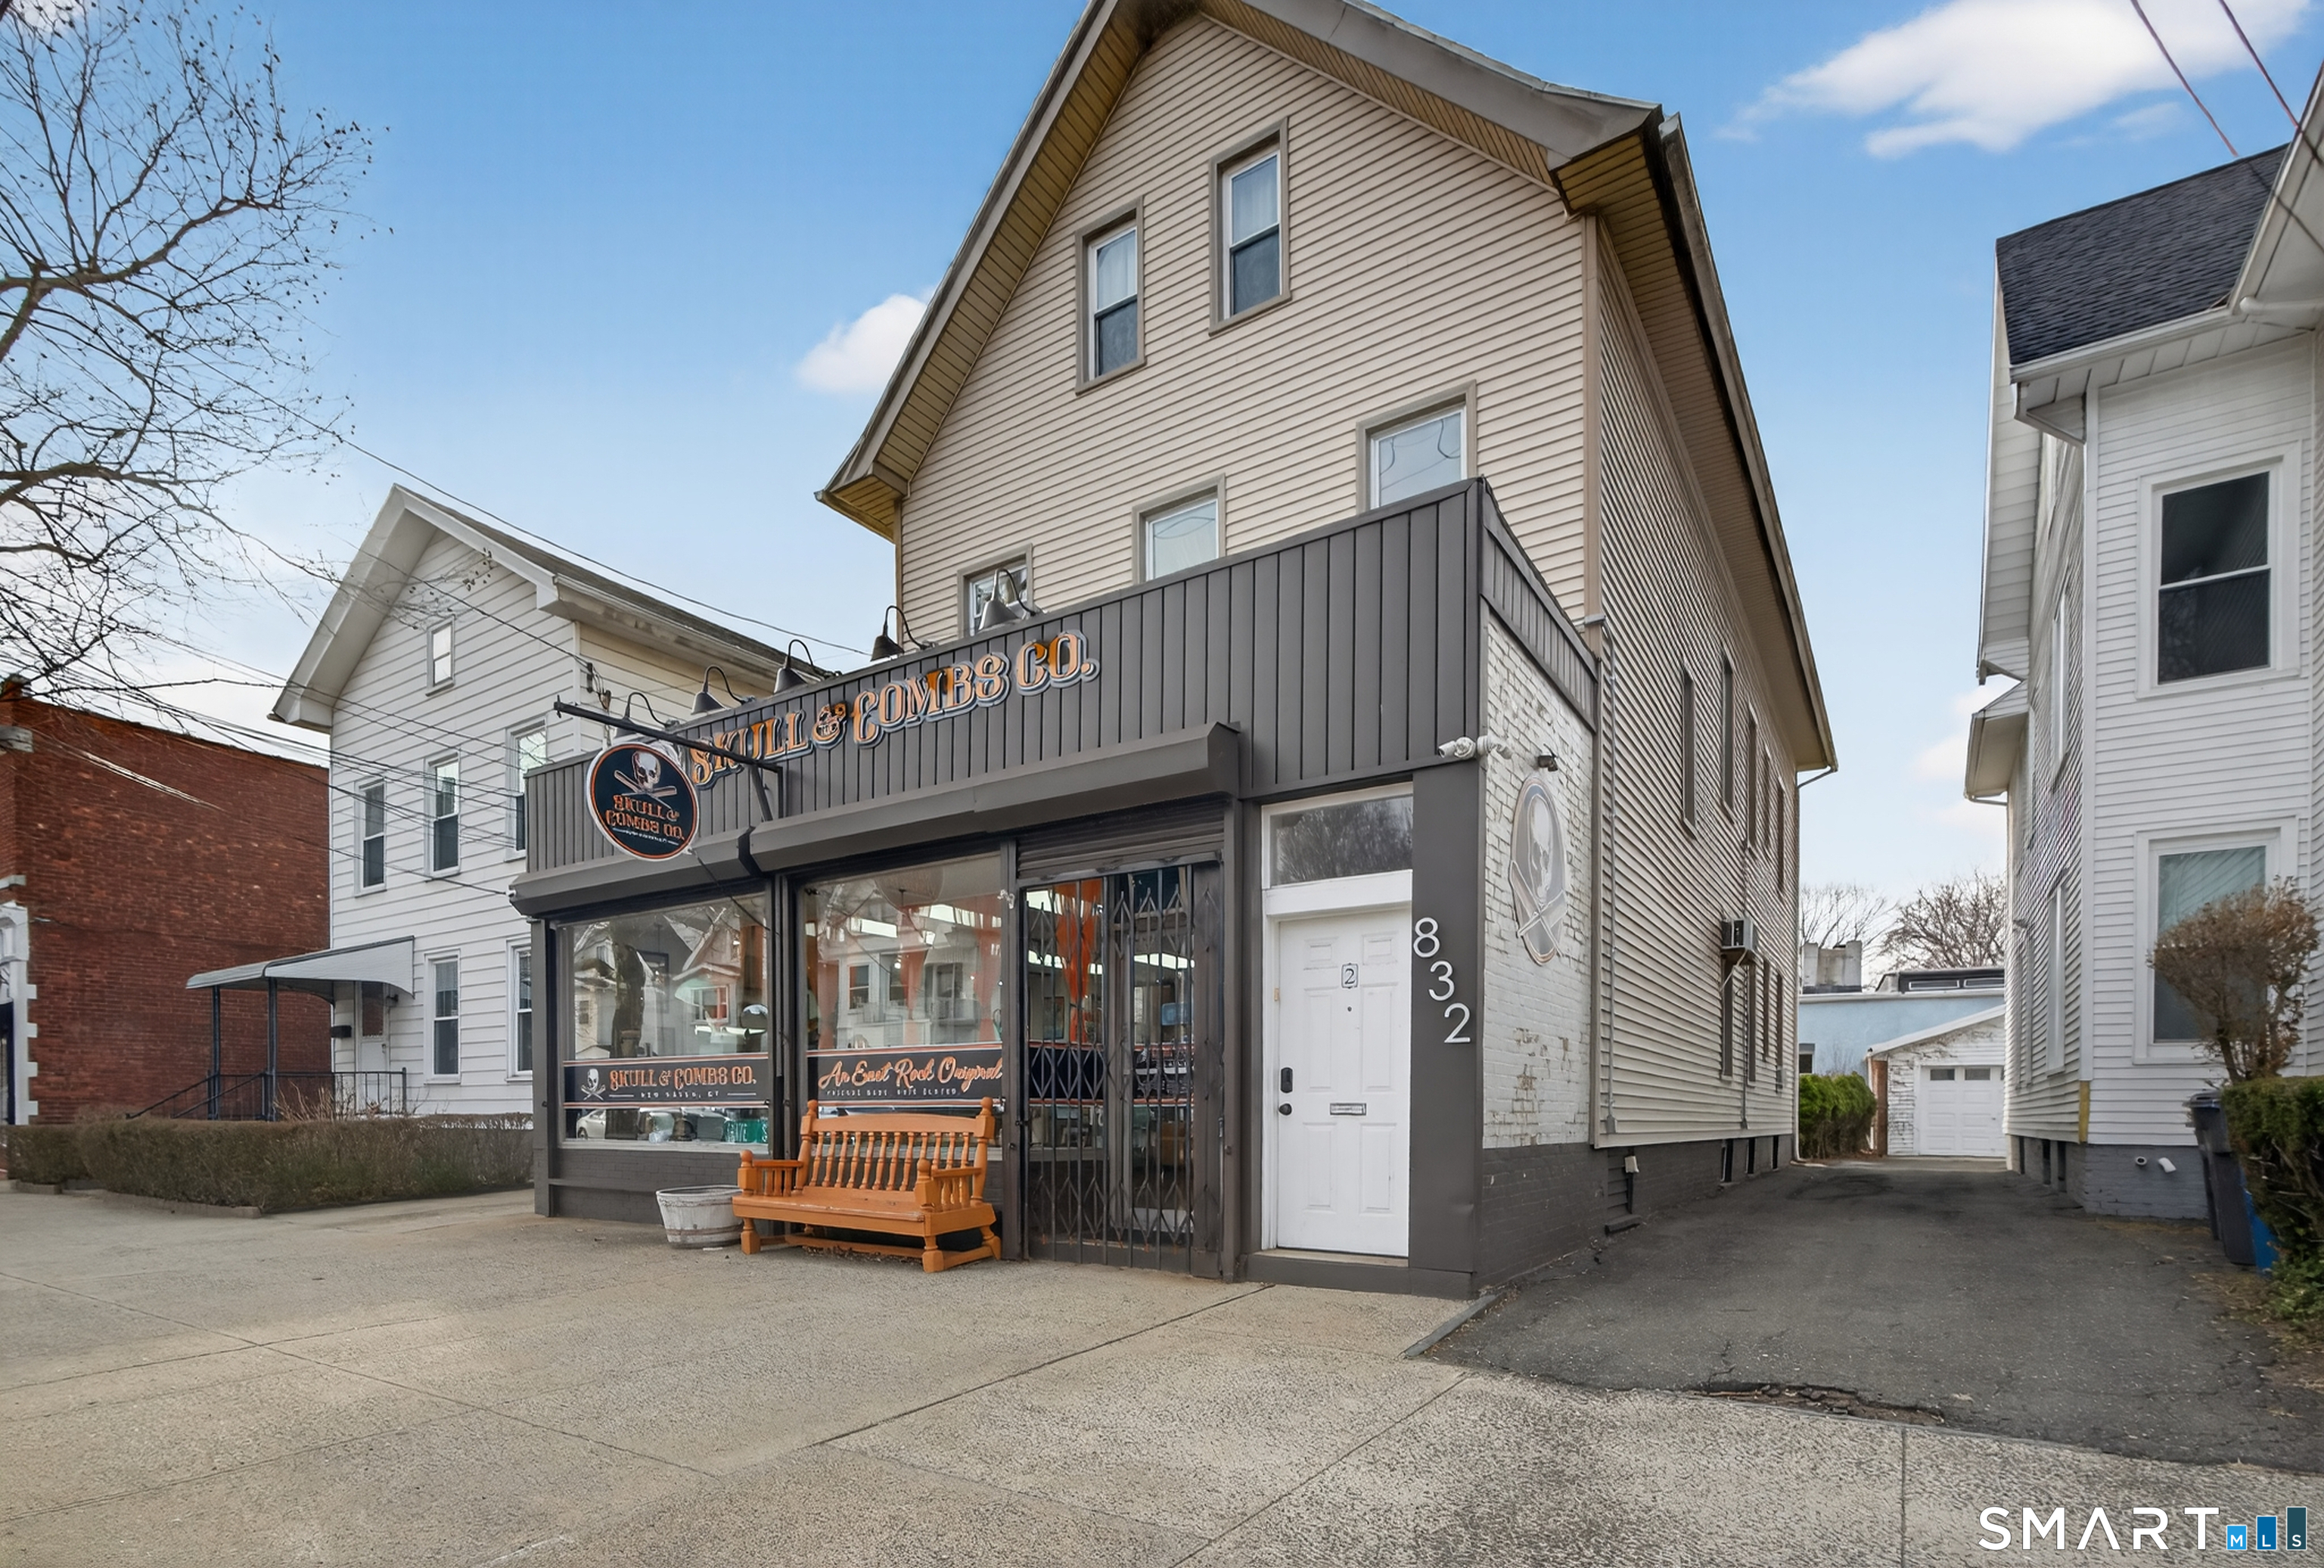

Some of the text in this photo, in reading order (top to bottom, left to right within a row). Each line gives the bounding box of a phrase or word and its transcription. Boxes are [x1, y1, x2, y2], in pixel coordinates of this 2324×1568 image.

[688, 629, 1100, 789] SKULL & COMBS CO.
[613, 794, 666, 820] SKULL
[605, 809, 660, 834] COMBS
[1344, 967, 1356, 985] 2
[1413, 917, 1471, 1043] 832
[609, 1065, 757, 1091] SKULL & COMBS CO.
[819, 1060, 850, 1090] An
[851, 1060, 894, 1087] East
